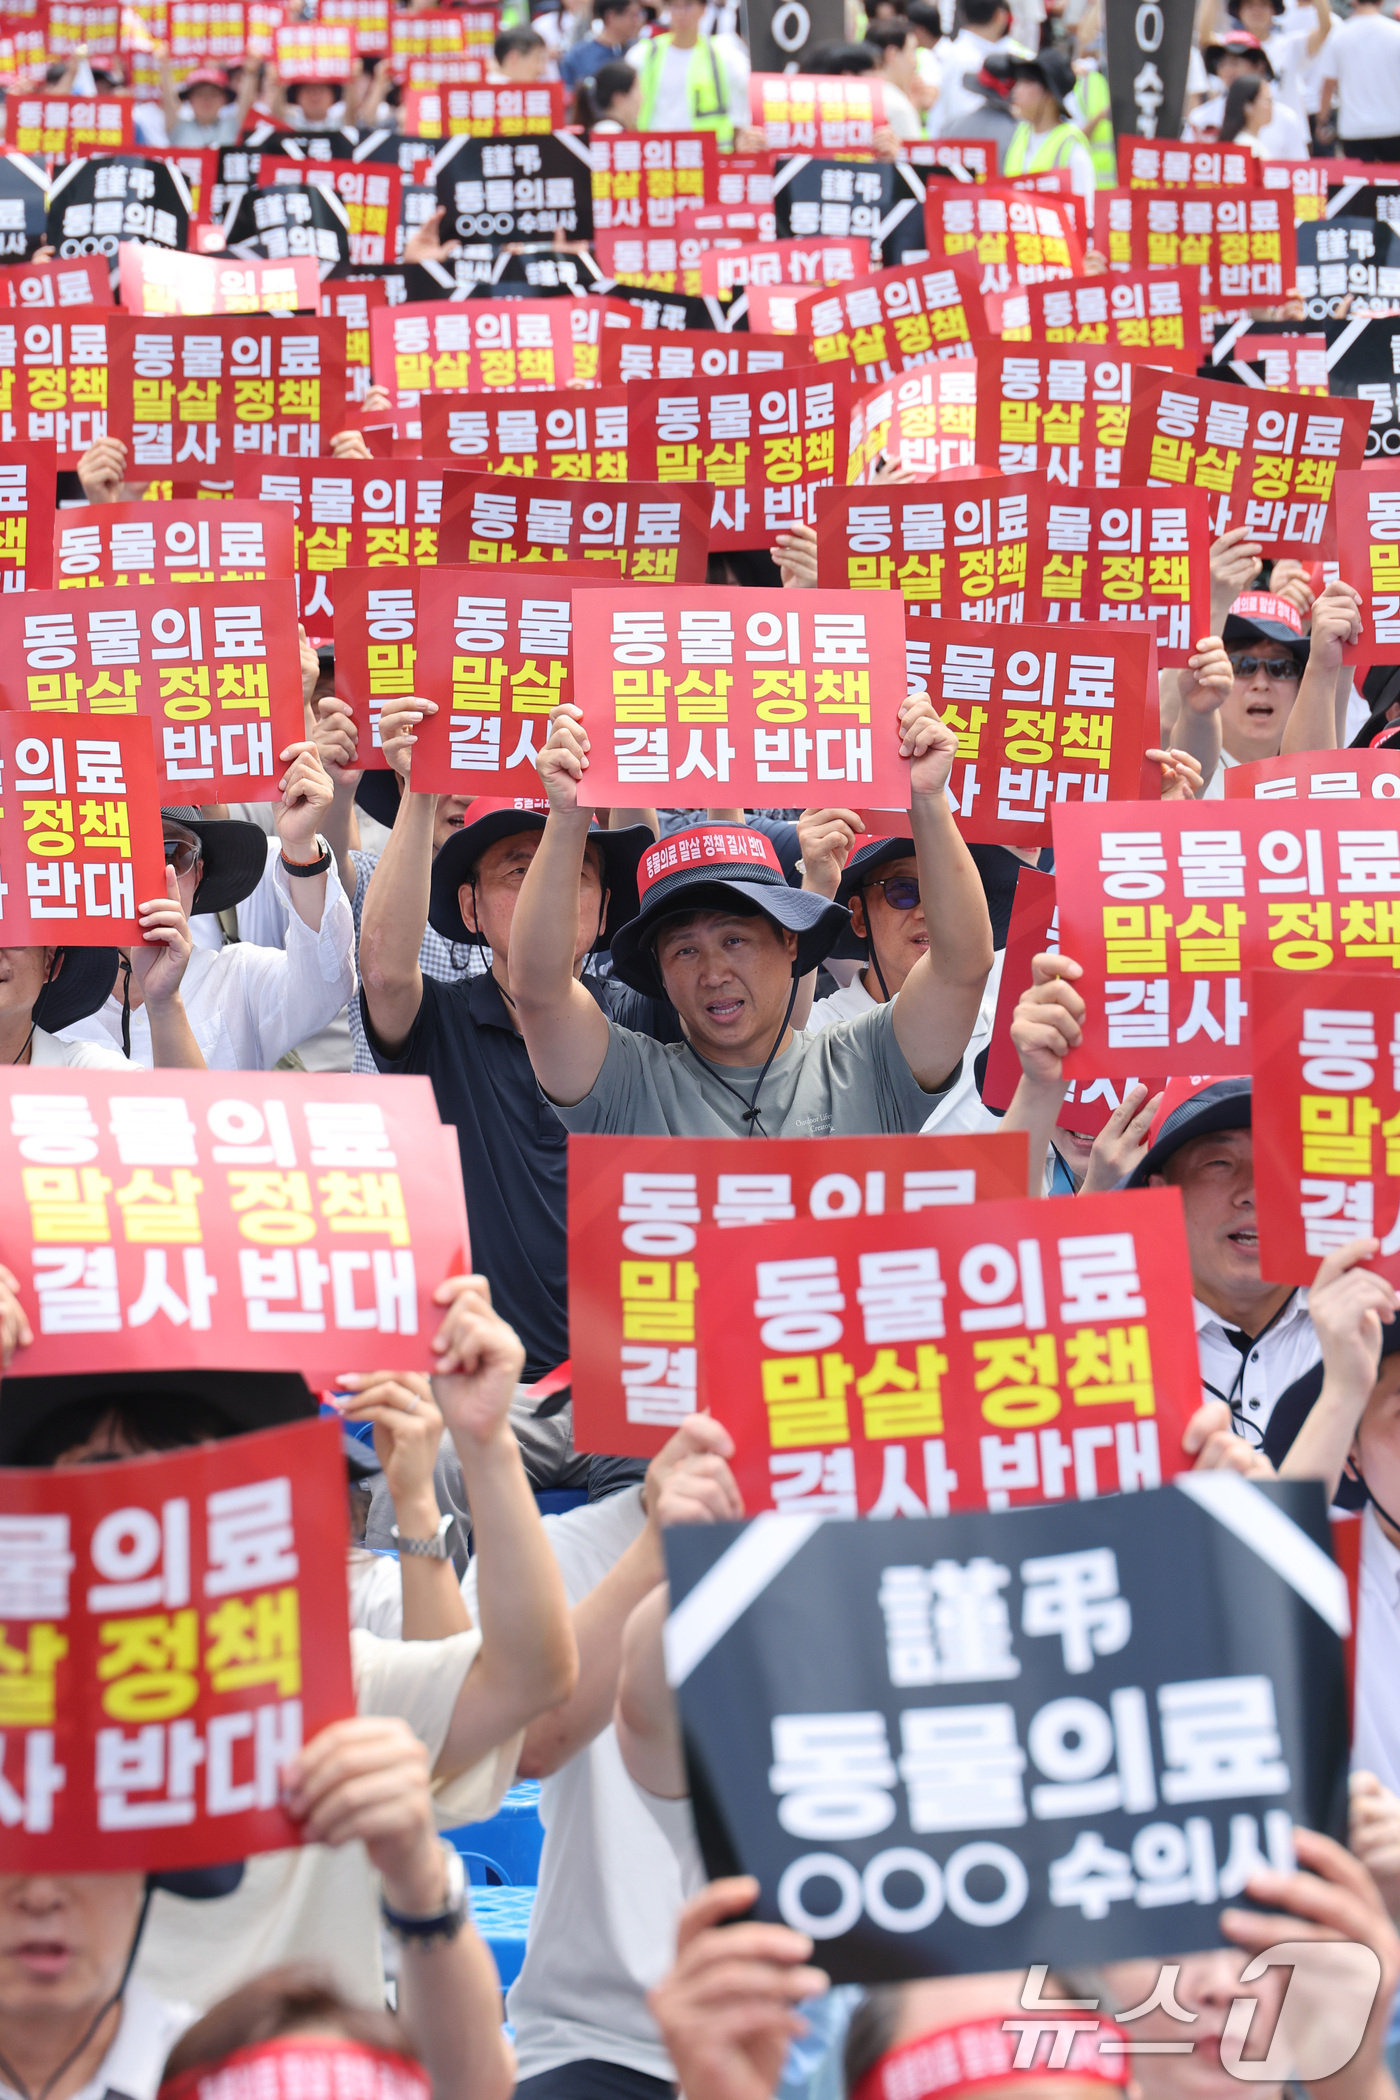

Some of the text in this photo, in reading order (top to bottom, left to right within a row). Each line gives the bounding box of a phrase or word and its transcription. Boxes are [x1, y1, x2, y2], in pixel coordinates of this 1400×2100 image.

[811, 269, 963, 338] 동물의료
[1042, 281, 1183, 328] 동물의료
[1218, 262, 1283, 297] 반대
[133, 334, 322, 378] 동물의료
[393, 312, 554, 354] 동물의료
[28, 367, 108, 411] 정책
[394, 350, 471, 390] 말살
[480, 348, 556, 388] 정책
[133, 380, 321, 423] 말살 정책
[447, 405, 628, 455] 동물의료
[655, 382, 835, 442] 동물의료
[999, 401, 1085, 444] 말살
[1157, 390, 1344, 457] 동물의료
[132, 423, 221, 466] 결사
[655, 441, 751, 487] 말살
[764, 428, 835, 484] 정책
[1149, 435, 1339, 502] 말살 정책
[259, 474, 444, 524] 동물의료
[470, 492, 682, 546] 동물의료
[846, 494, 1029, 553] 동물의료
[1238, 499, 1329, 546] 반대
[59, 521, 266, 575] 동물의료
[1046, 505, 1190, 553] 물의료
[847, 542, 1028, 600] 말살 정책
[1101, 556, 1191, 602] 정책
[23, 606, 267, 670] 동물의료
[610, 610, 871, 664] 동물의료
[26, 663, 271, 722] 말살 정책
[452, 656, 568, 714] 말살
[612, 669, 871, 724] 말살 정책
[162, 722, 274, 781] 반대
[613, 728, 873, 783] 결사 반대
[1003, 708, 1113, 770] 정책
[23, 799, 132, 858] 정책
[646, 844, 678, 879] 동물의료
[679, 836, 702, 863] 말살
[702, 833, 727, 857] 정책
[726, 834, 748, 856] 결사
[26, 862, 136, 920] 반대
[1098, 829, 1400, 900] 동물의료
[1102, 900, 1400, 974] 말살 정책
[1104, 977, 1248, 1048] 결사
[11, 1094, 398, 1168] 동물의료
[795, 1116, 820, 1127] Outdoor
[21, 1166, 411, 1246] 말살 정책
[32, 1246, 419, 1336] 결사 반대
[754, 1232, 1148, 1353] 동물의료
[760, 1325, 1157, 1450] 말살 정책
[768, 1438, 959, 1521] 결사
[96, 1586, 302, 1724] 정책
[94, 1698, 304, 1832] 반대
[768, 1673, 1291, 1841] 동물의료
[1047, 1808, 1299, 1921] 수의사
